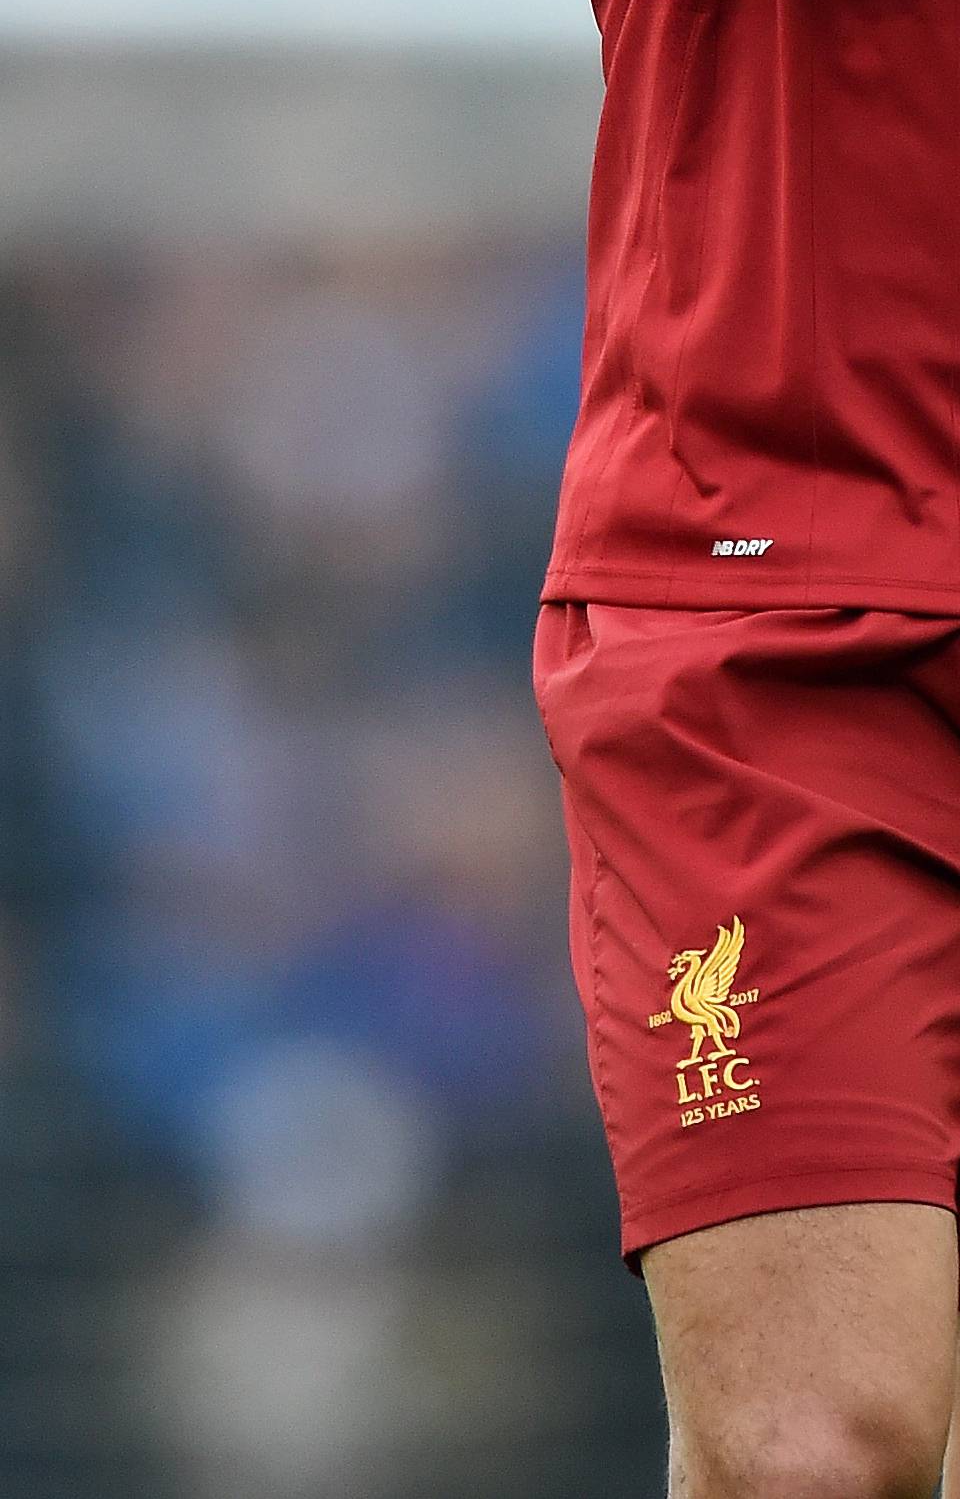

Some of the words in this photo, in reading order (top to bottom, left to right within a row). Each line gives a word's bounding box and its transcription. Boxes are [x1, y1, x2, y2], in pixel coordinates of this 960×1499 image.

[733, 539, 774, 556] DRY
[729, 988, 760, 1007] 2017
[676, 1057, 761, 1104] L.F.C.
[680, 1107, 705, 1127] 125
[705, 1093, 761, 1120] YEARS
